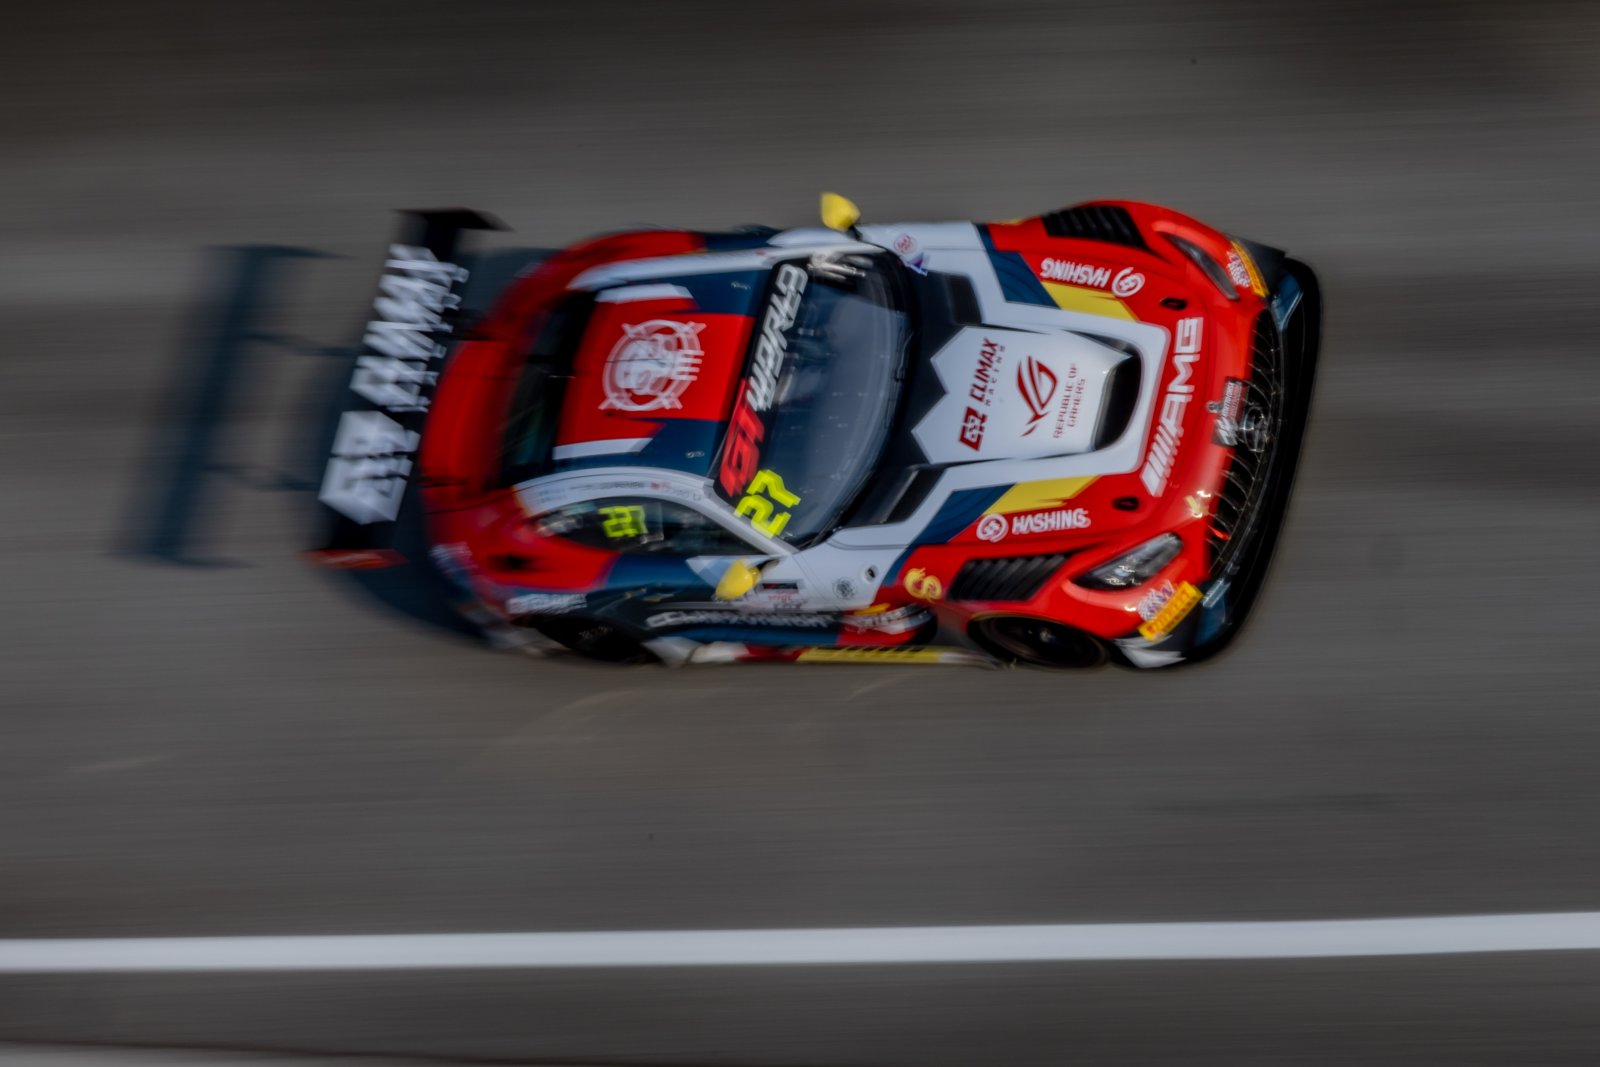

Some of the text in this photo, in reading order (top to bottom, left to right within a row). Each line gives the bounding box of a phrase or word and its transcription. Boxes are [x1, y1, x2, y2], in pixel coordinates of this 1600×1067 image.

[1040, 258, 1111, 289] HASHING
[746, 264, 808, 412] WORLD
[968, 337, 1000, 402] CLIMAX
[1053, 362, 1079, 440] REPUBLIC OF
[1068, 378, 1086, 428] GAMERS
[734, 469, 801, 539] 27
[1012, 508, 1091, 535] HASHING
